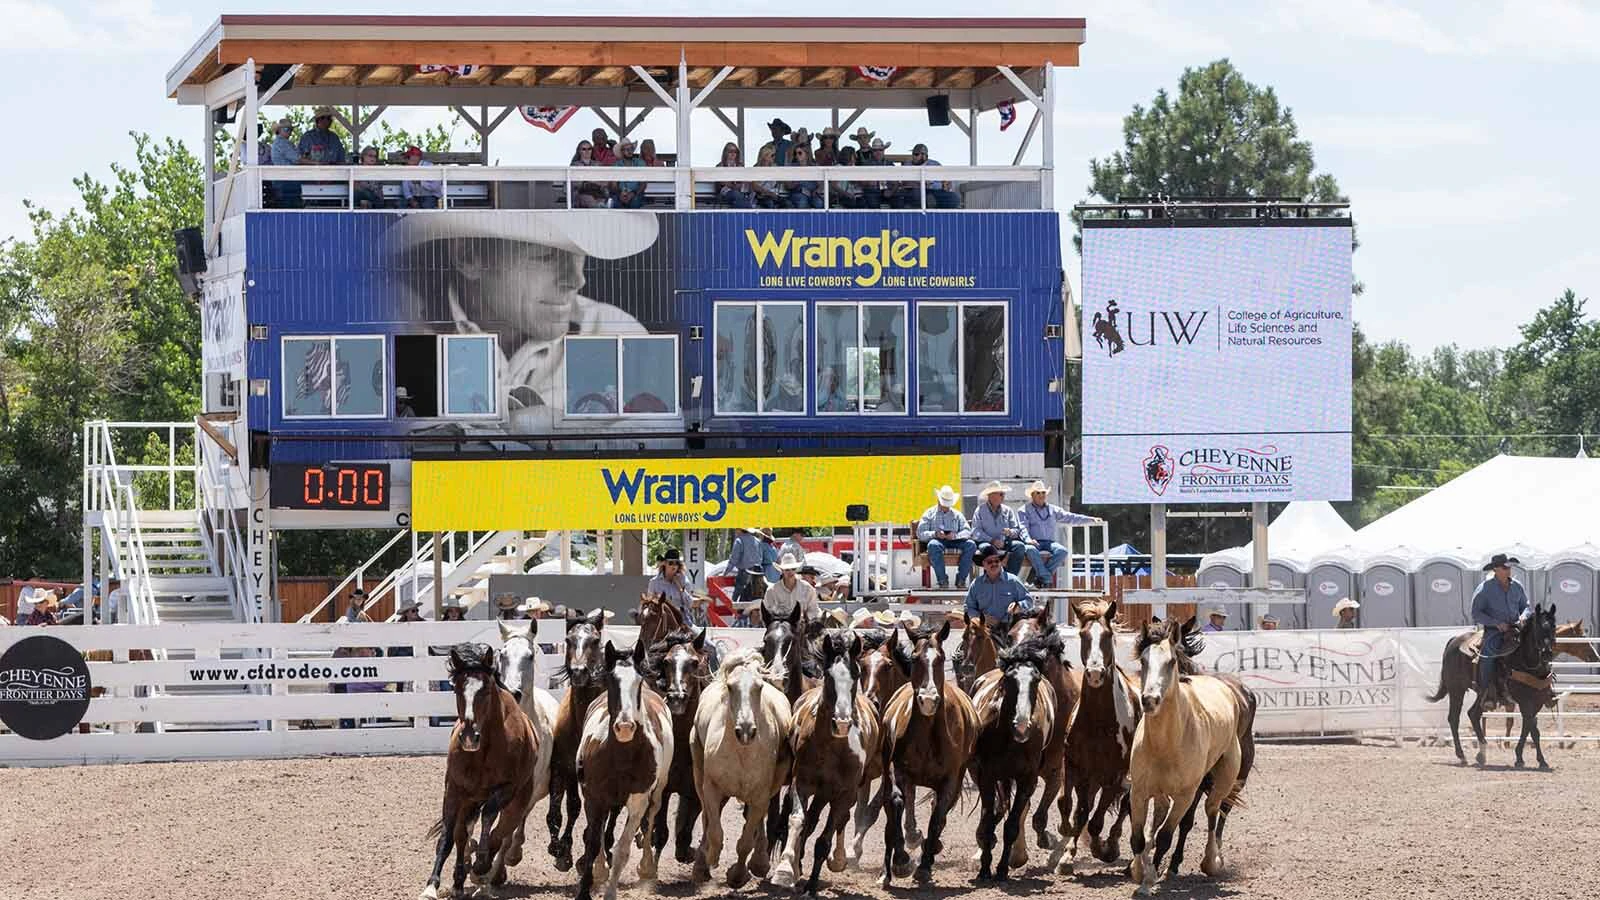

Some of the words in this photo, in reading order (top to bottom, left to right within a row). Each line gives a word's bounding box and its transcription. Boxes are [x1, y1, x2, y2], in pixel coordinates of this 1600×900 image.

[744, 229, 936, 287] Wrangler
[760, 276, 783, 287] LONG
[786, 276, 806, 287] LIVE
[808, 276, 852, 287] COWBOYS
[882, 276, 906, 287] LONG
[908, 276, 928, 287] LIVE
[929, 276, 975, 287] COWGIRLS
[1227, 310, 1268, 321] College
[1270, 310, 1281, 320] of
[1284, 310, 1344, 321] Agriculture,
[1126, 311, 1208, 346] UW
[1228, 322, 1247, 333] Life
[1250, 322, 1295, 333] Sciences
[1298, 322, 1318, 333] and
[1228, 336, 1266, 346] Natural
[1268, 335, 1322, 346] Resources
[1179, 448, 1292, 473] CHEYENNE
[1182, 474, 1249, 486] FRONTIER
[1254, 474, 1289, 485] DAYS
[601, 467, 776, 522] Wrangler
[614, 513, 636, 524] LONG
[639, 512, 656, 523] LIVE
[659, 512, 699, 523] COWBOYS
[190, 663, 378, 681] www.cfdrodeo.com
[1214, 647, 1397, 685] CHEYENNE
[0, 668, 87, 690] CHEYENNE
[0, 690, 53, 700] FRONTIER
[56, 690, 84, 700] DAYS
[1338, 687, 1391, 705] DAYS
